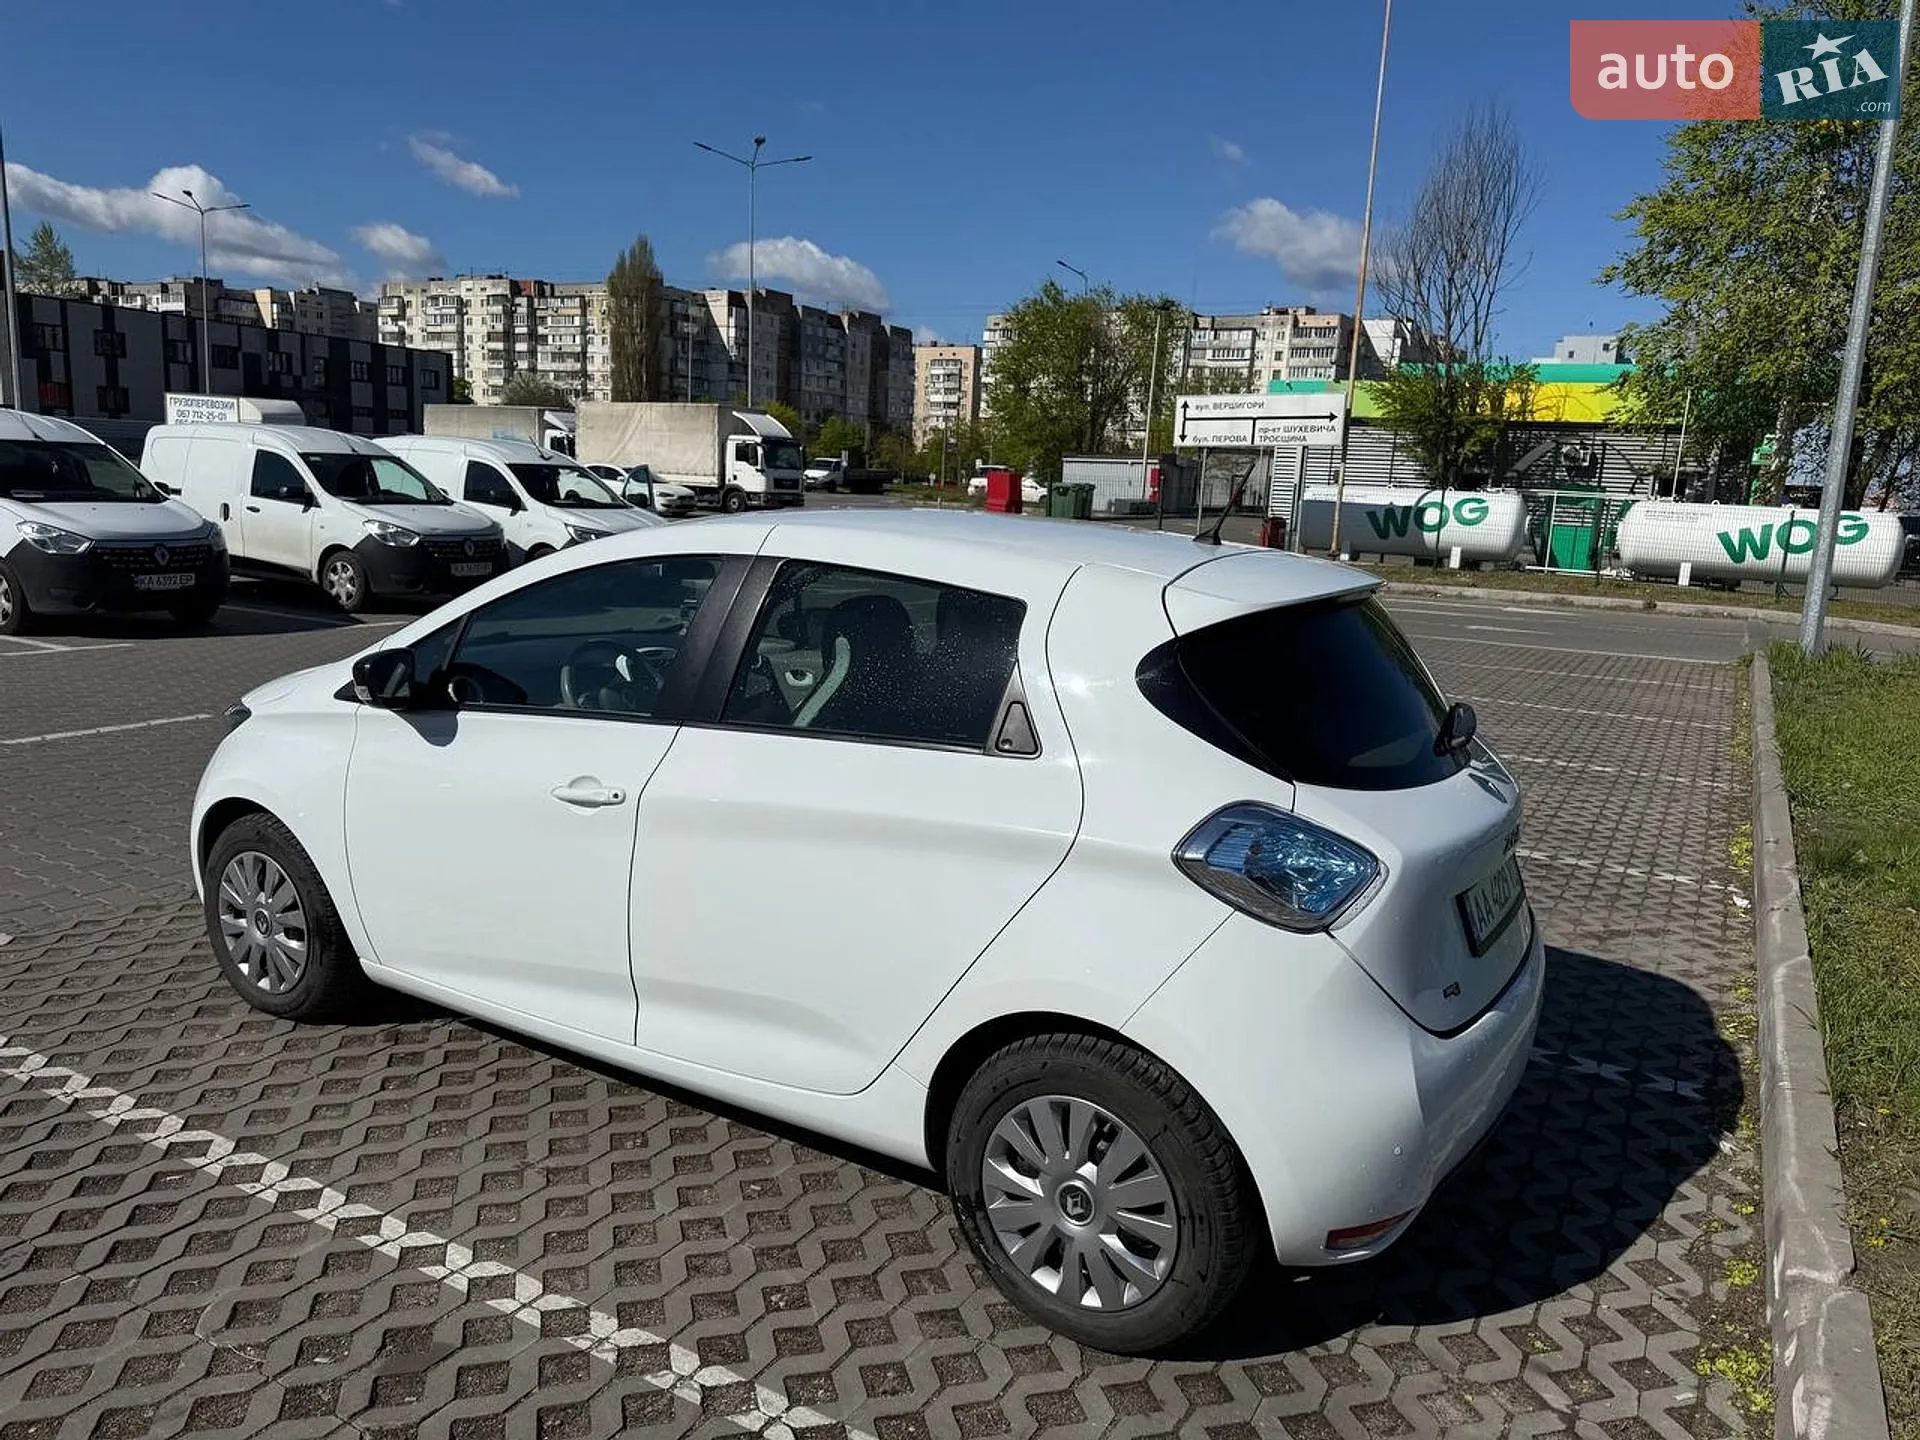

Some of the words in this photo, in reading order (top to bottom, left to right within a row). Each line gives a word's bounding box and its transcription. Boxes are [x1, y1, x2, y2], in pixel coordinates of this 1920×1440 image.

[169, 397, 235, 410] ГРУЗОПЕРЕВОЗКИ
[1195, 403, 1211, 412] вул.
[1212, 401, 1265, 411] ВЕРШИГОРИ
[176, 409, 191, 418] 067
[1282, 424, 1337, 433] ШУХЕВИЧА
[1213, 435, 1248, 443] ПЕРОВА
[1365, 497, 1489, 540] WOG
[1716, 514, 1869, 564] WOG
